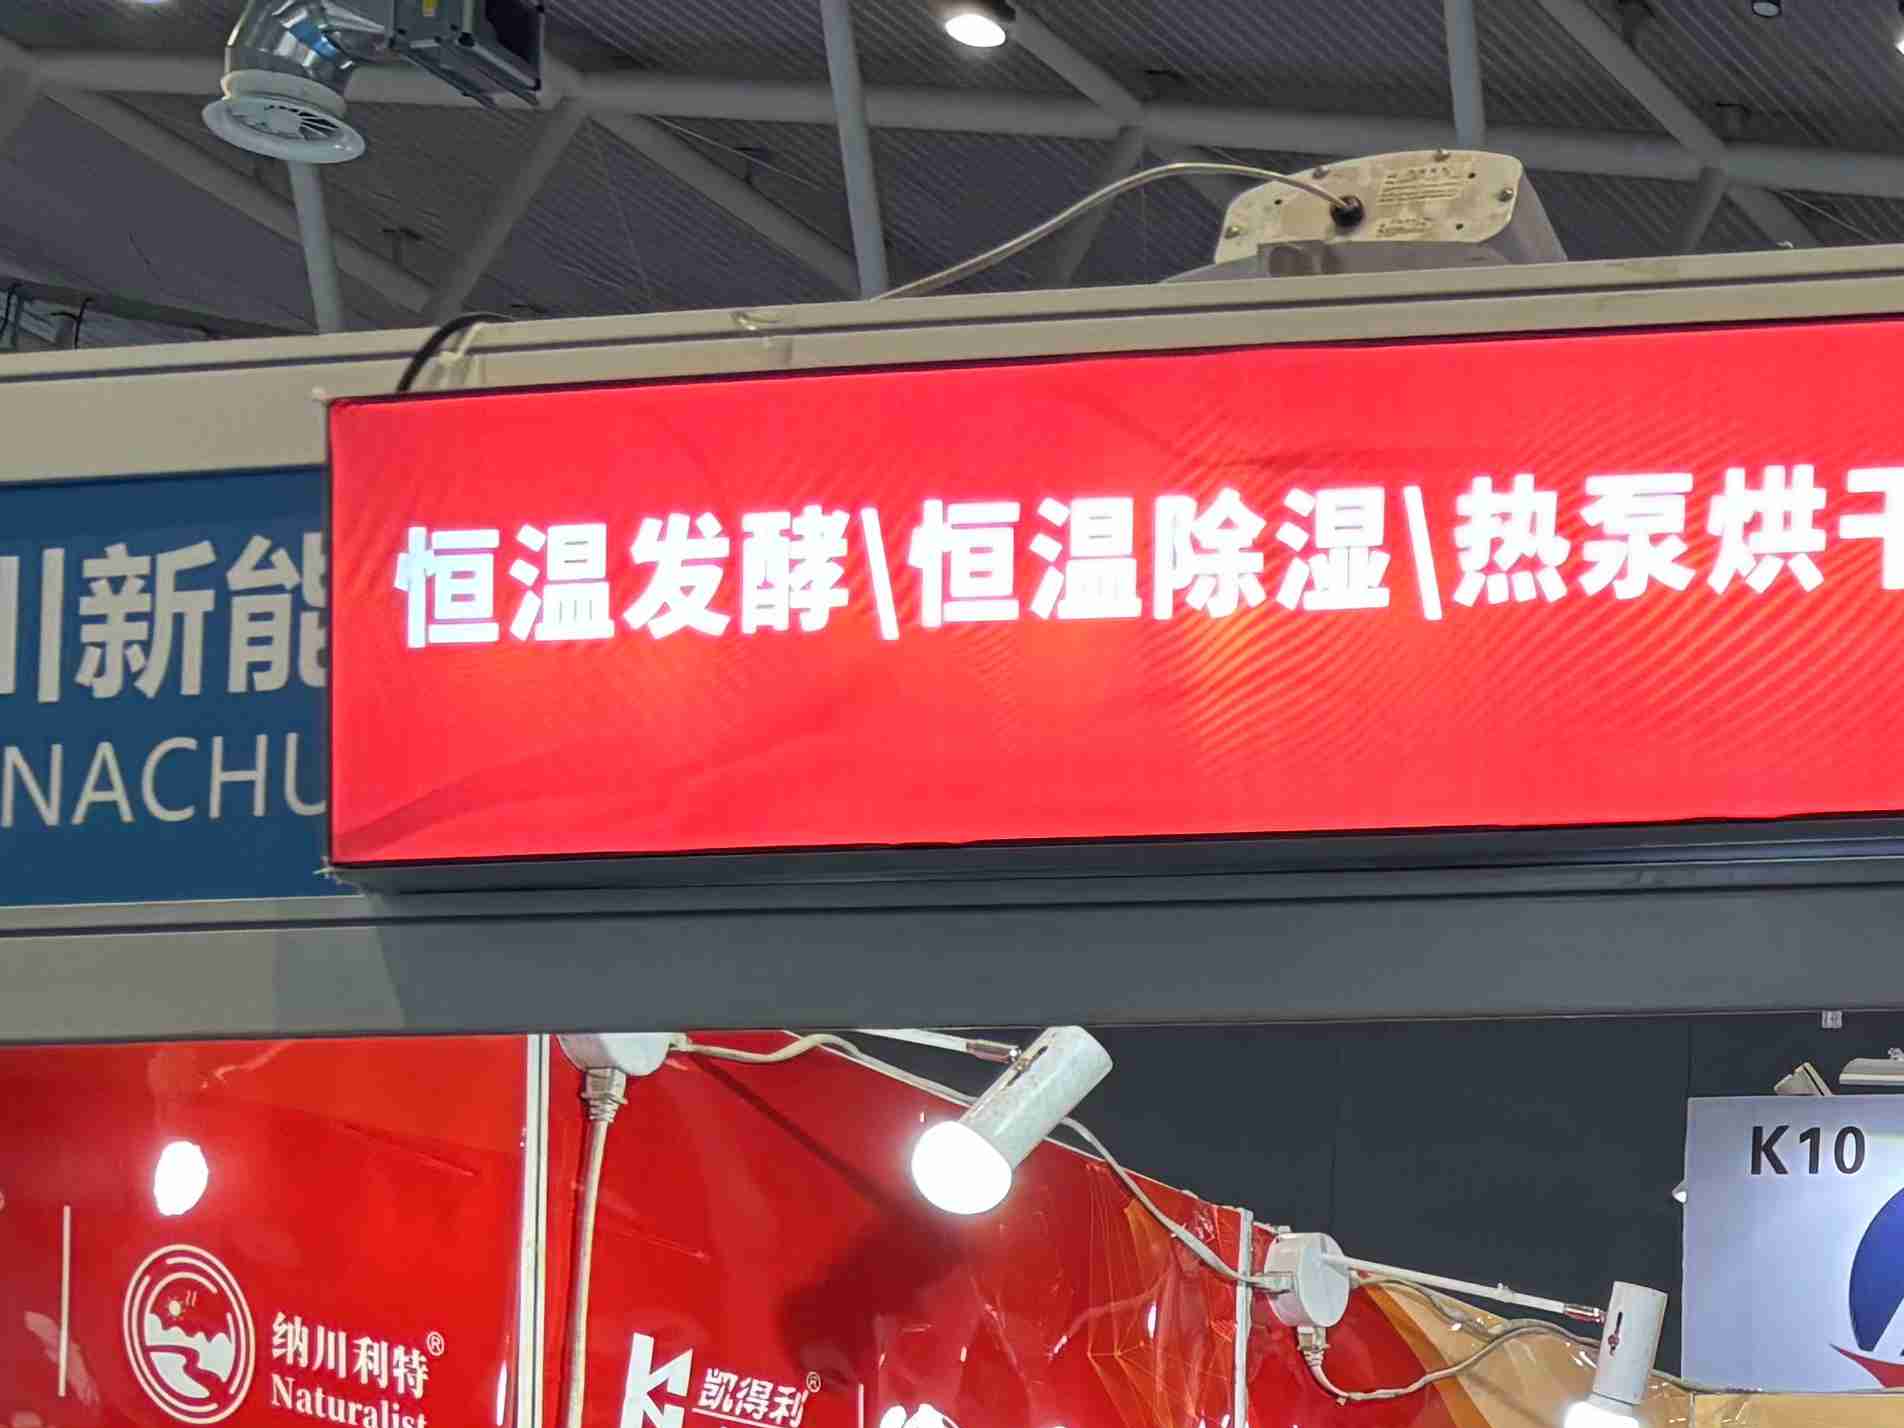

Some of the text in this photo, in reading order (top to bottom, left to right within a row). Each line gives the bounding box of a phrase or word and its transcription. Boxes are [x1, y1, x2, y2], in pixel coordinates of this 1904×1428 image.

[1751, 1125, 1866, 1175] K10
[271, 1311, 428, 1402] 纳川利特
